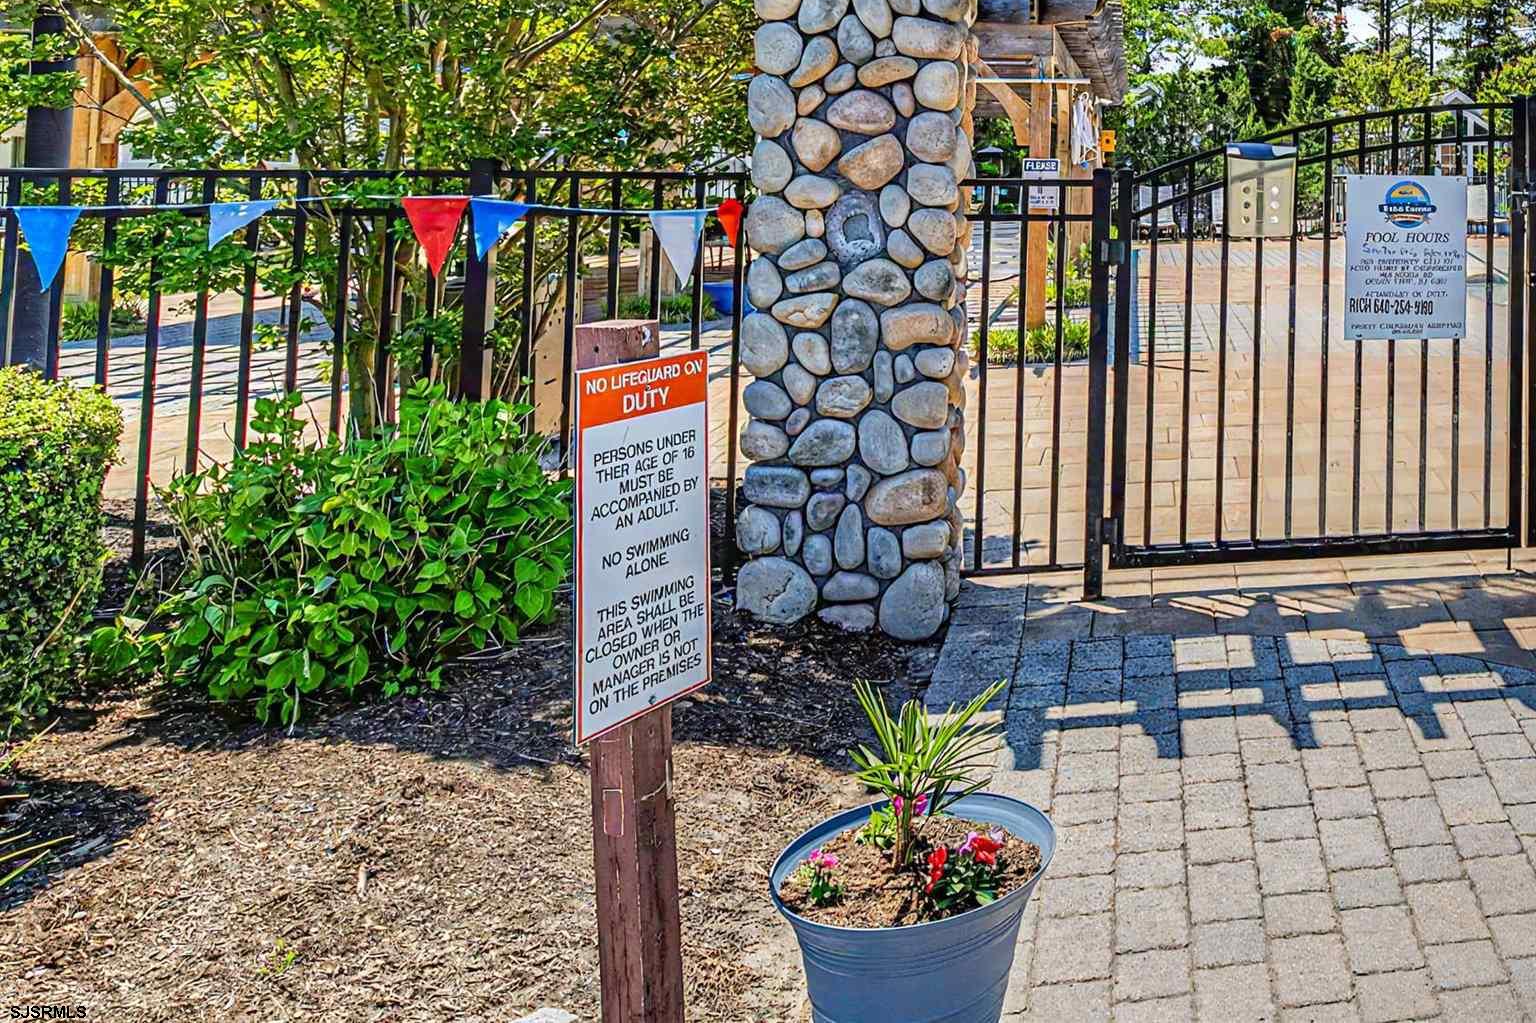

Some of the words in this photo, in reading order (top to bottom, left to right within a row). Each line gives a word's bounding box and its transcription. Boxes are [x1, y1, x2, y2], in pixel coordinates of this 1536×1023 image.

[1406, 232, 1450, 243] HOURS
[1349, 298, 1371, 313] RICH
[586, 377, 606, 394] NO
[611, 363, 680, 389] LIFEGUARD
[683, 358, 702, 376] ON
[623, 386, 669, 414] DUTY
[594, 439, 653, 467] PERSONS
[657, 428, 695, 451] UNDER
[635, 455, 657, 473] AGE
[662, 450, 677, 465] OF
[682, 446, 694, 460] 16
[591, 481, 680, 520] ACCOMPANIED
[684, 476, 698, 491] BY
[619, 472, 654, 494] MUST
[658, 467, 673, 483] BE
[615, 512, 632, 530] AN
[637, 498, 678, 523] ADULT.
[602, 550, 621, 569] NO
[626, 527, 689, 561] SWIMMING
[597, 599, 626, 624] THIS
[631, 574, 693, 611] SWIMMING
[598, 614, 632, 641] AREA
[637, 598, 675, 625] SHALL
[679, 590, 694, 608] BE
[585, 630, 636, 664] CLOSED
[642, 613, 677, 639] WHEN
[681, 602, 704, 623] THE
[613, 637, 658, 670] OWNER
[664, 628, 680, 647] OR
[589, 694, 608, 715] ON
[613, 680, 638, 704] THE
[643, 651, 701, 690] PREMISES
[593, 656, 654, 697] MANAGER
[659, 649, 669, 665] IS
[674, 636, 697, 659] NOT
